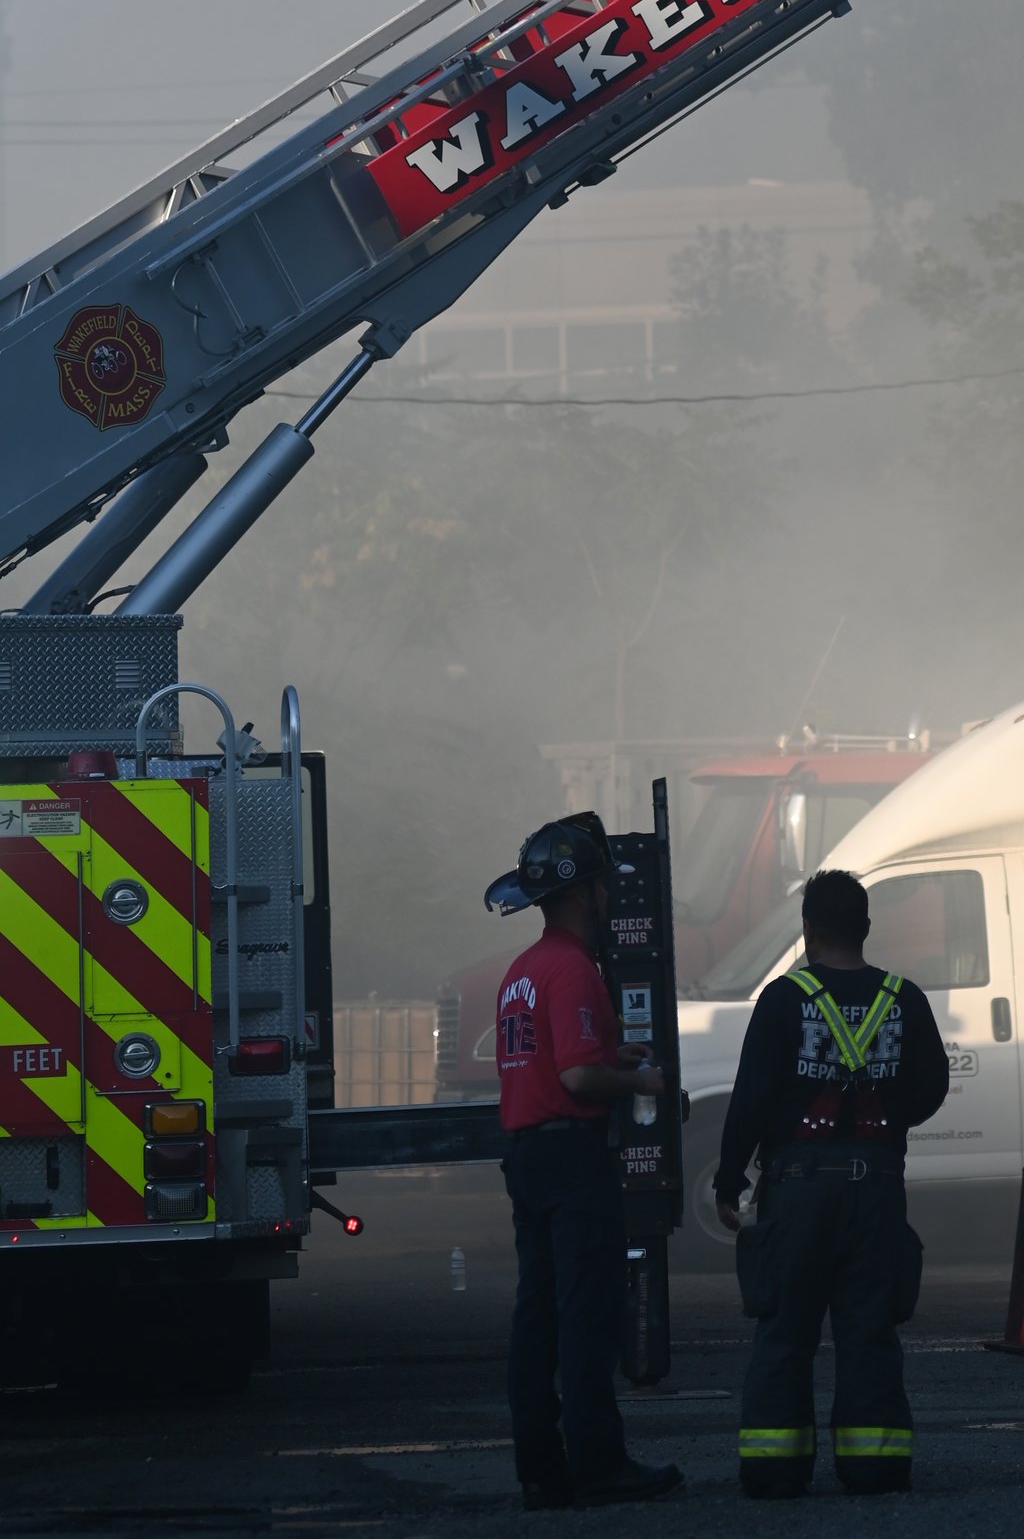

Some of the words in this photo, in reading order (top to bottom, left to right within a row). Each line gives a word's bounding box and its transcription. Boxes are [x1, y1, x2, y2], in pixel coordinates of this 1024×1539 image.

[67, 316, 117, 353] WAKEFIELD
[63, 362, 97, 414] FIRE
[611, 918, 653, 931] CHECK
[618, 932, 648, 944] PINS
[13, 1048, 62, 1072] FEET
[627, 1160, 657, 1173] PINS
